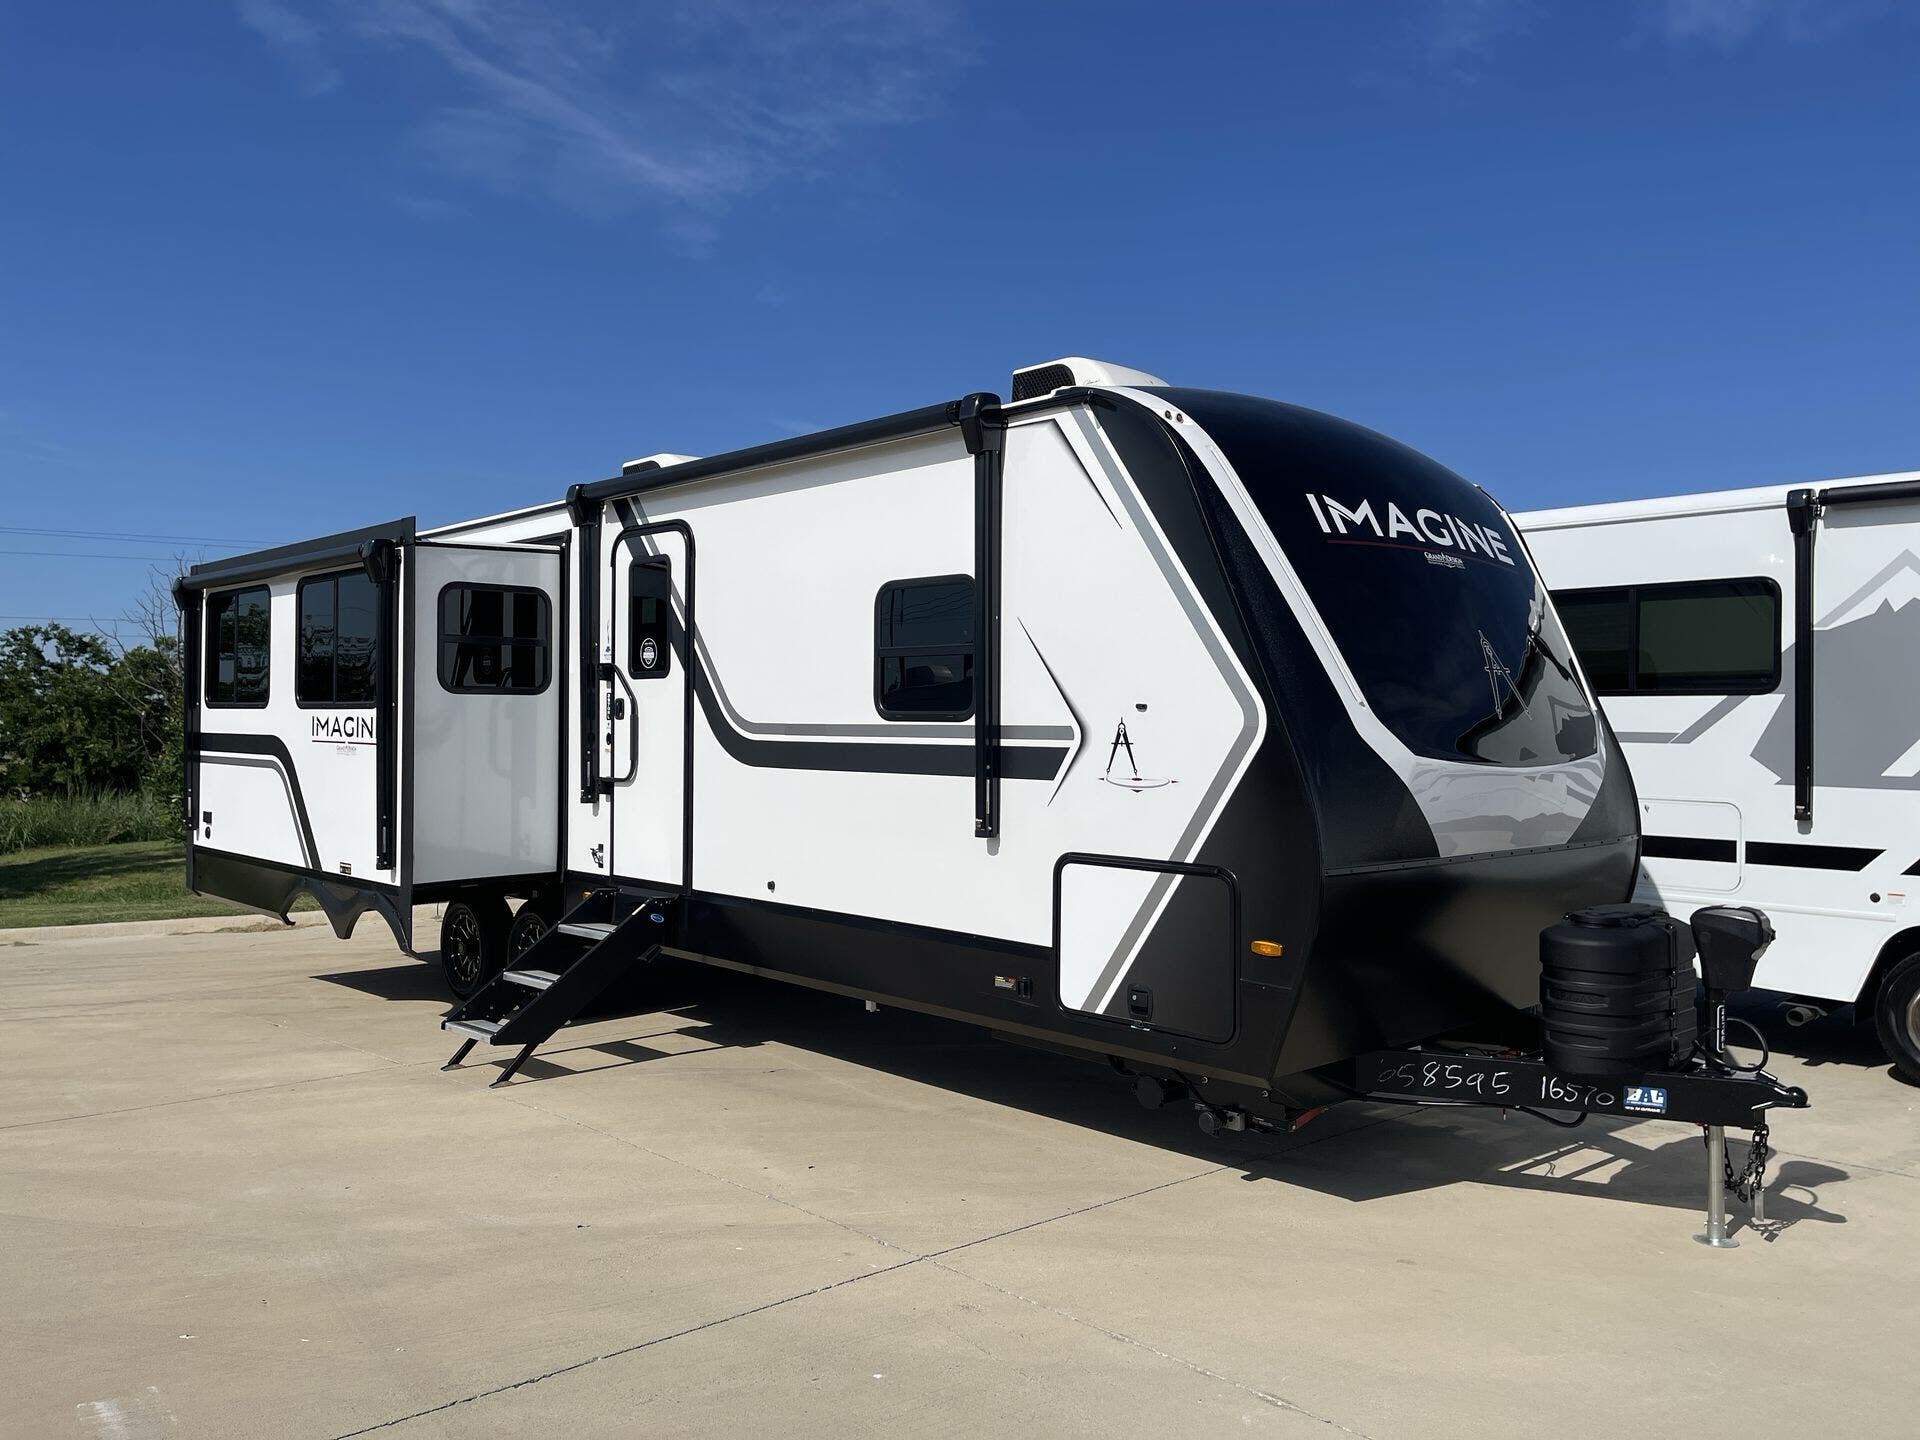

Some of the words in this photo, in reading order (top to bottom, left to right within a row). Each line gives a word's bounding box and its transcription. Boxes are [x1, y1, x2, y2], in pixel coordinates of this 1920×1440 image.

[1305, 493, 1516, 567] IMAGINE
[311, 715, 375, 739] IMAGIN
[1541, 1075, 1615, 1106] 16570
